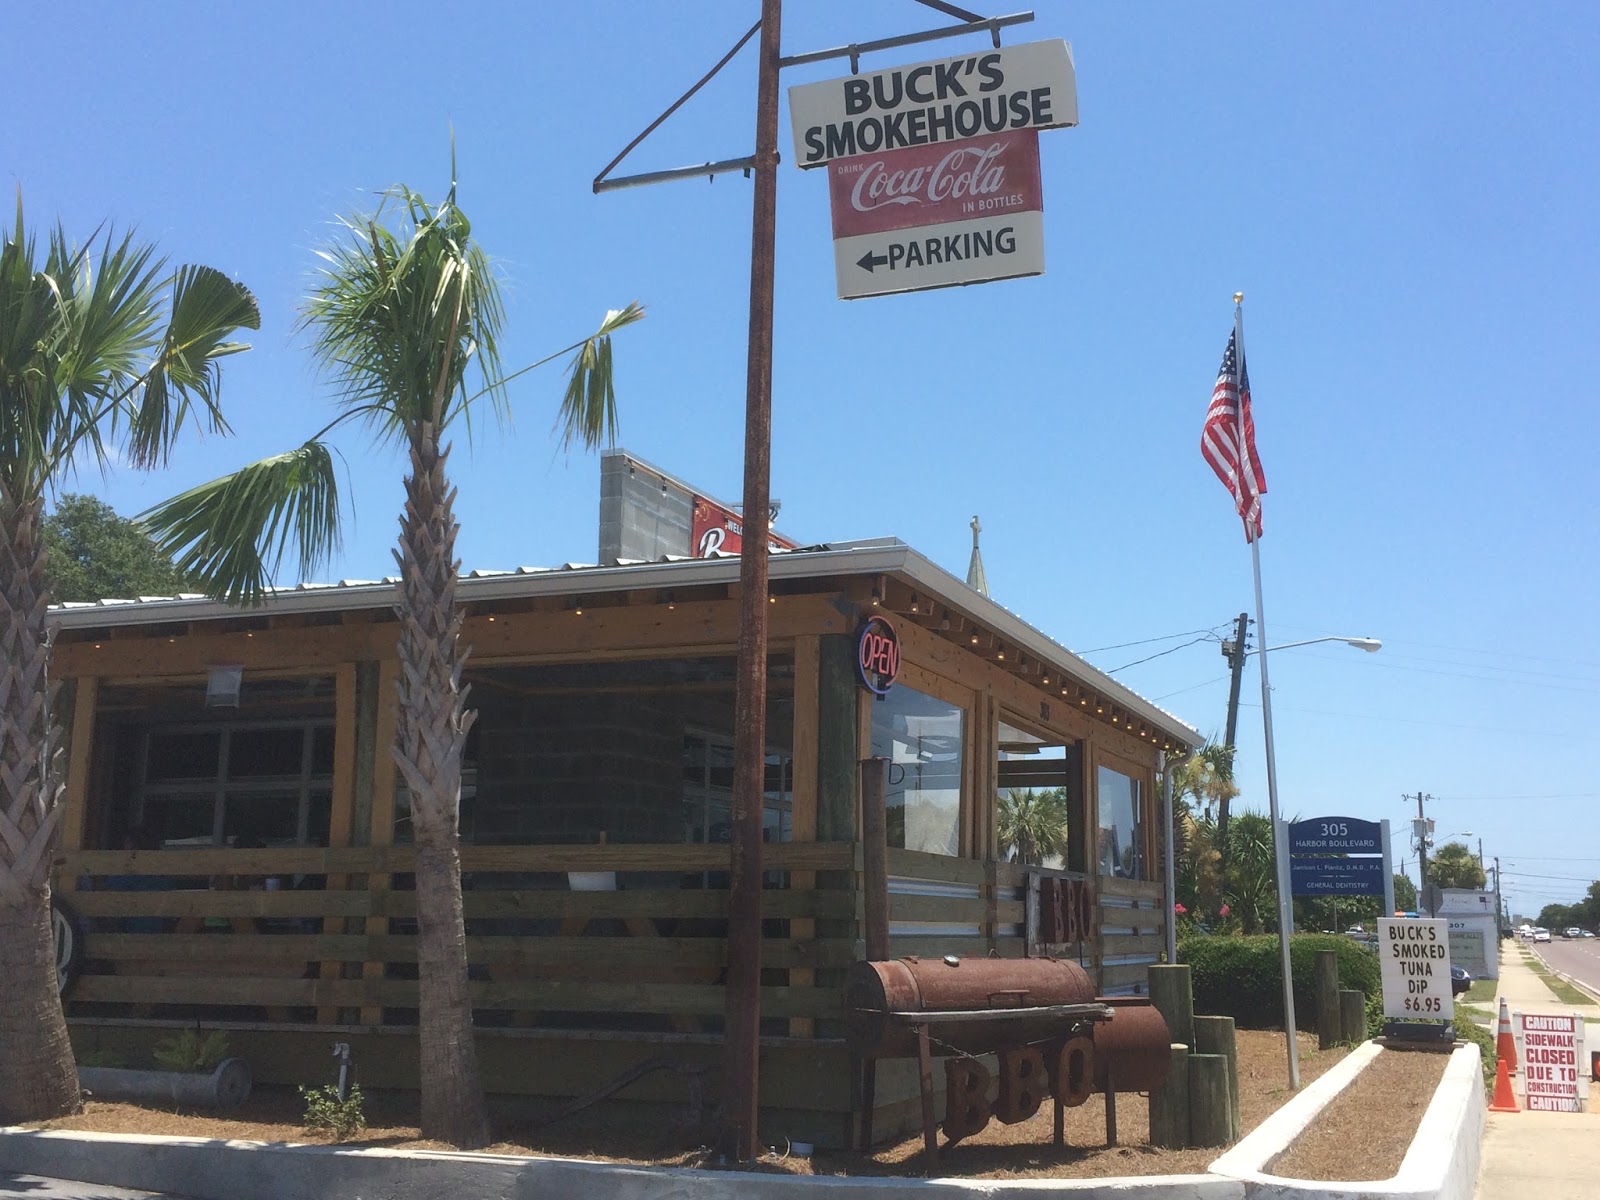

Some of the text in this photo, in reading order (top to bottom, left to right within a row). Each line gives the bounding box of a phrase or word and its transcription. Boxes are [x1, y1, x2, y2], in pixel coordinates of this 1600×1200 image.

[843, 53, 1005, 116] BUCK'S
[804, 86, 1054, 162] SMOKEHOUSE
[838, 163, 865, 175] DRINK
[851, 141, 1010, 212] Coca-Cola
[962, 194, 1024, 213] IN BOTTLES
[888, 227, 1017, 270] PARKING
[862, 632, 899, 677] OPEN
[1320, 823, 1348, 836] 305
[1389, 926, 1436, 941] BUCK'S
[1392, 943, 1445, 959] SMOKED
[1399, 961, 1433, 977] TUNA
[1404, 997, 1441, 1012] $6.95
[1525, 1016, 1572, 1031] CAUTION
[1525, 1033, 1574, 1047] SIDEWALK
[1526, 1048, 1575, 1065] CLOSED
[1527, 1066, 1576, 1081] DUE TO
[1527, 1081, 1577, 1095] CONSTRUCTION
[1530, 1096, 1577, 1112] CAUTION
